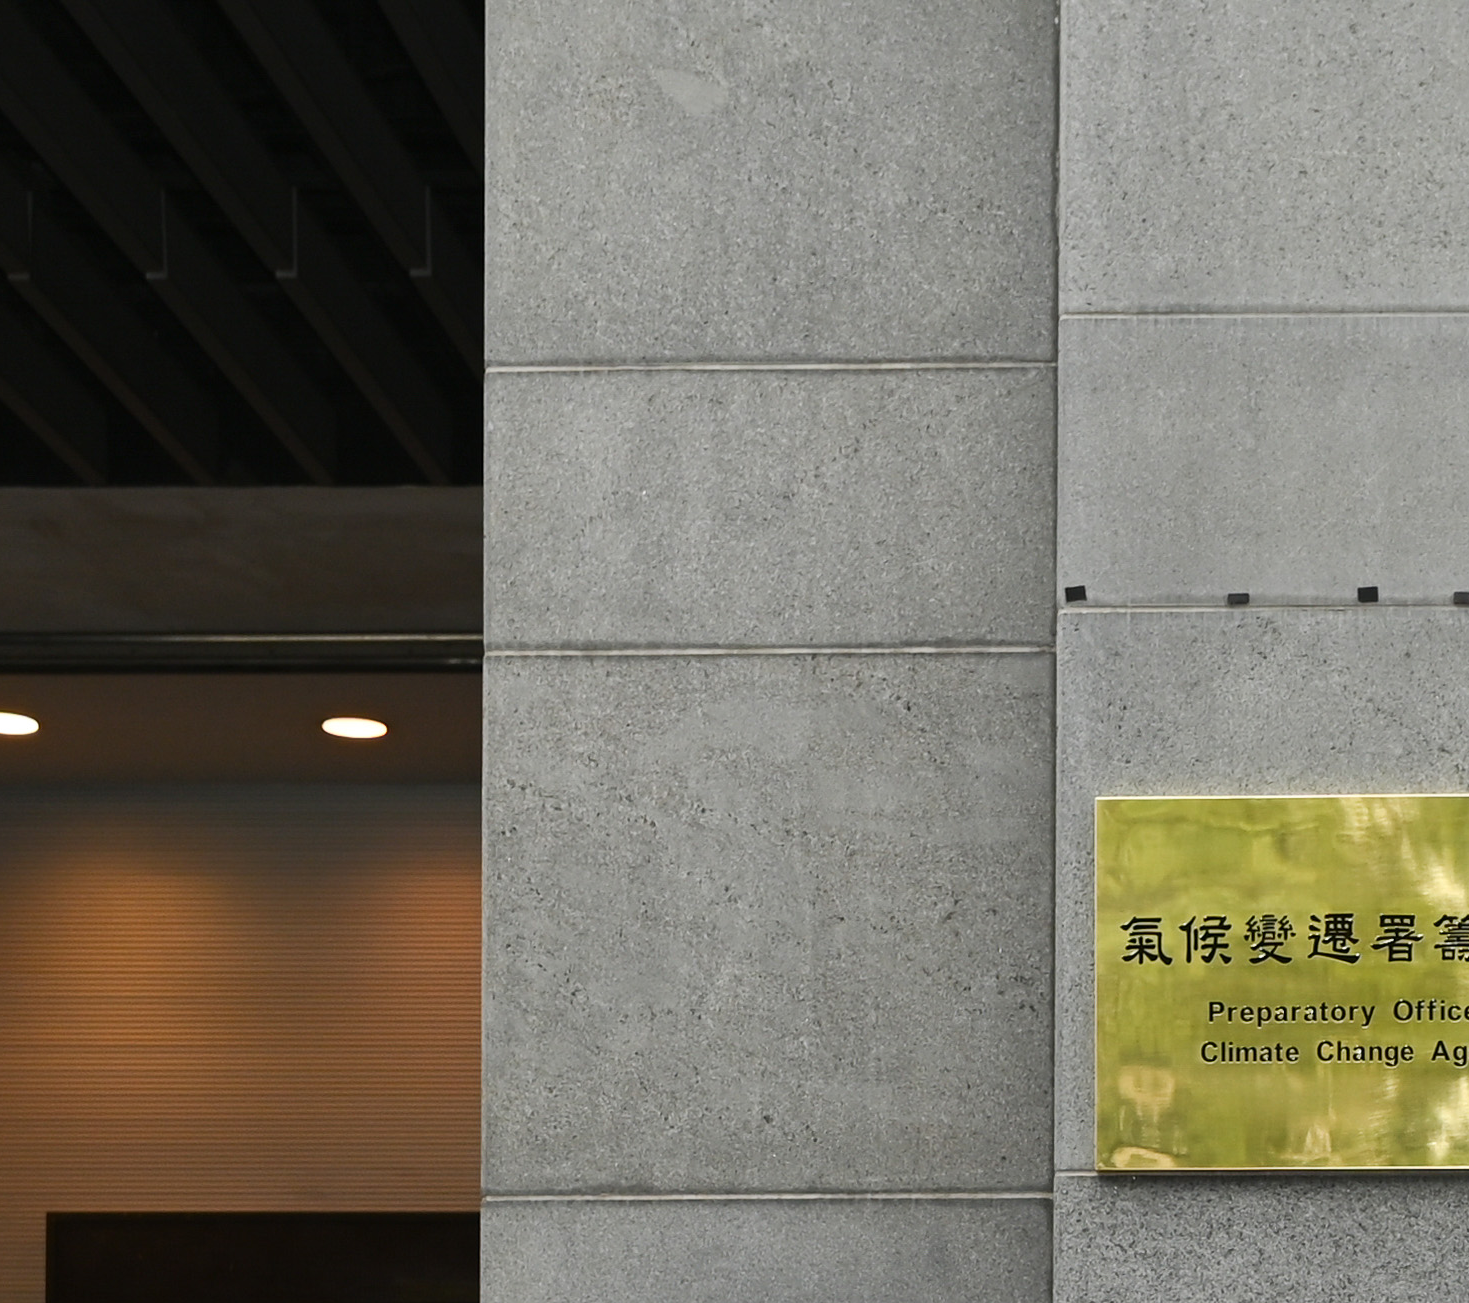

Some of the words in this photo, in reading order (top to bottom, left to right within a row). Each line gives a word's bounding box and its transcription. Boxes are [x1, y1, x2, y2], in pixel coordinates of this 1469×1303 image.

[1207, 1000, 1376, 1027] Preparatory
[1200, 1041, 1299, 1063] Climate
[1316, 1040, 1415, 1067] Change
